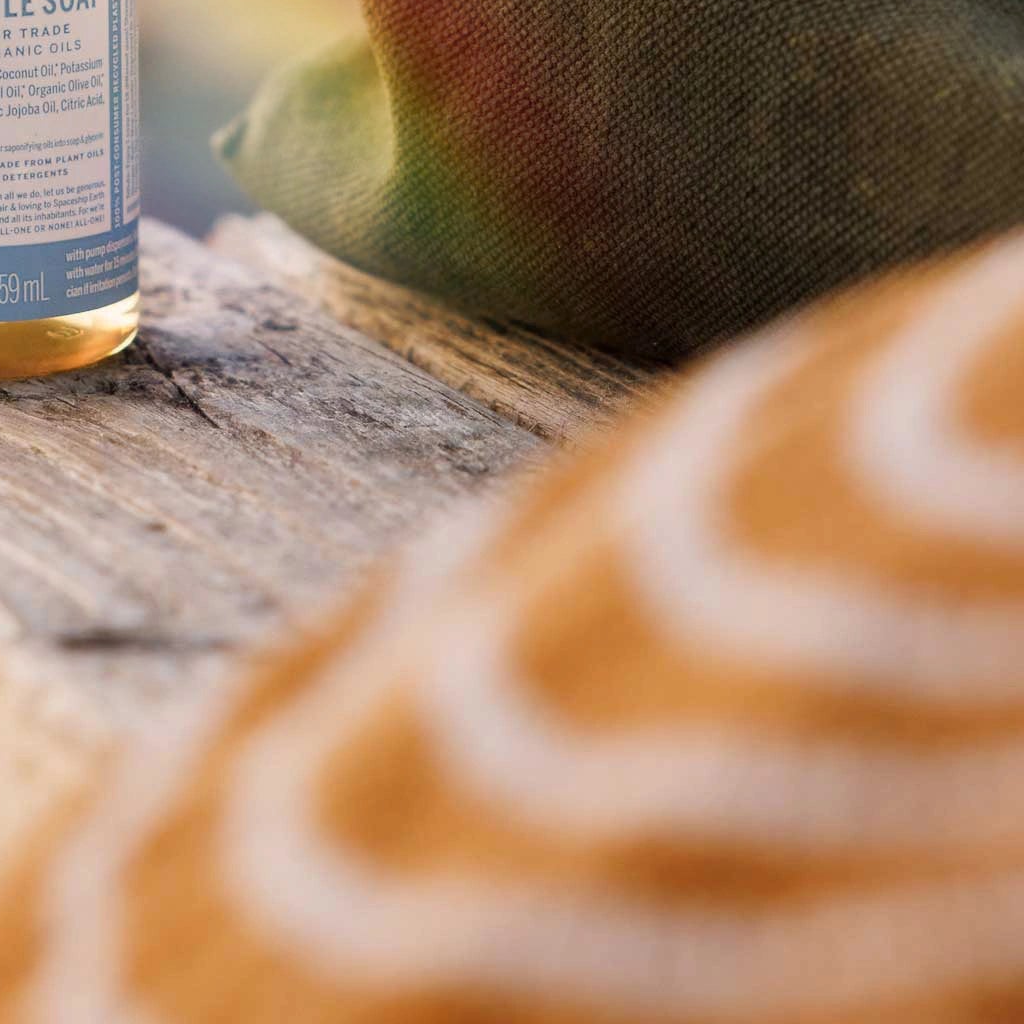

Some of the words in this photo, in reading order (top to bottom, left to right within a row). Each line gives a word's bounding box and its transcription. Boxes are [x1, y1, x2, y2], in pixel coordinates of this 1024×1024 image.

[20, 23, 71, 38] TRADE
[49, 39, 82, 54] OILS
[60, 57, 103, 75] Potassium
[112, 34, 120, 93] RECYCLED
[28, 80, 66, 98] Organic
[68, 79, 90, 92] Olive
[5, 102, 40, 119] Jojoba
[42, 100, 59, 114] Oil,
[60, 97, 85, 112] Citric
[112, 96, 120, 194] POST-CONSUMER
[24, 157, 52, 167] FROM
[55, 153, 84, 163] PLANT
[87, 149, 104, 159] OILS
[2, 168, 69, 182] DETERGENTS
[4, 191, 15, 200] all
[43, 188, 54, 197] let
[56, 188, 65, 196] us
[66, 186, 75, 194] be
[10, 203, 16, 211] &
[18, 201, 42, 211] loving
[44, 200, 52, 209] to
[53, 195, 89, 208] Spaceship
[89, 191, 105, 201] Earth
[11, 215, 21, 223] all
[22, 214, 33, 222] its
[34, 224, 46, 233] OR
[48, 220, 74, 231] NONE!
[74, 215, 105, 227] ALL-ONE!
[65, 247, 84, 262] with
[85, 245, 106, 261] pump
[65, 266, 84, 280] with
[24, 271, 51, 303] mL
[65, 284, 83, 298] cian
